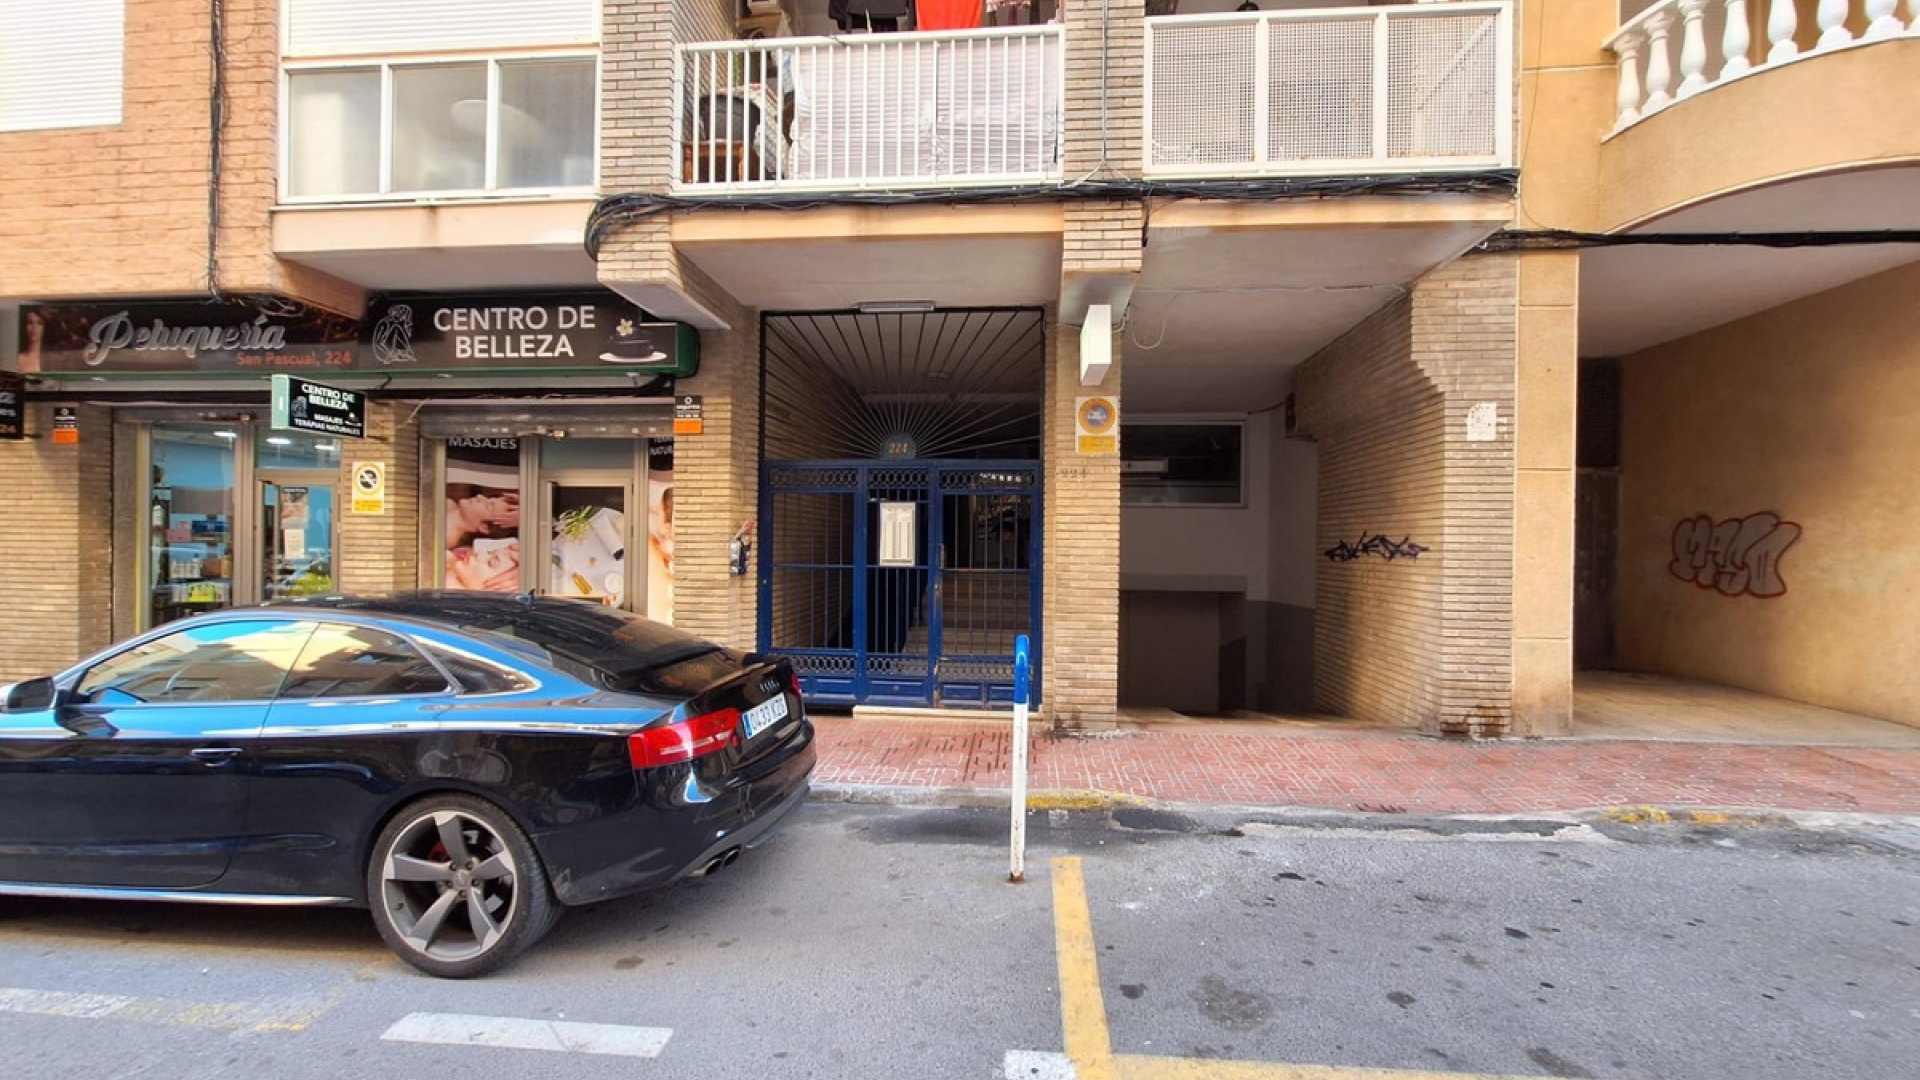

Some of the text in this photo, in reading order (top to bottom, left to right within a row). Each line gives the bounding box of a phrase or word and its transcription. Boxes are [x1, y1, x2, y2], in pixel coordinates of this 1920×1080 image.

[433, 305, 596, 331] CENTRO DE
[84, 311, 285, 366] Peluquería
[455, 335, 575, 359] BELLEZA
[236, 350, 352, 368] San Pascual, 224
[301, 383, 355, 403] CENTRO DE
[308, 394, 349, 410] BELLEZA
[314, 413, 343, 425] MASAJES
[325, 424, 361, 435] NATURALES
[448, 436, 518, 450] MASAJES
